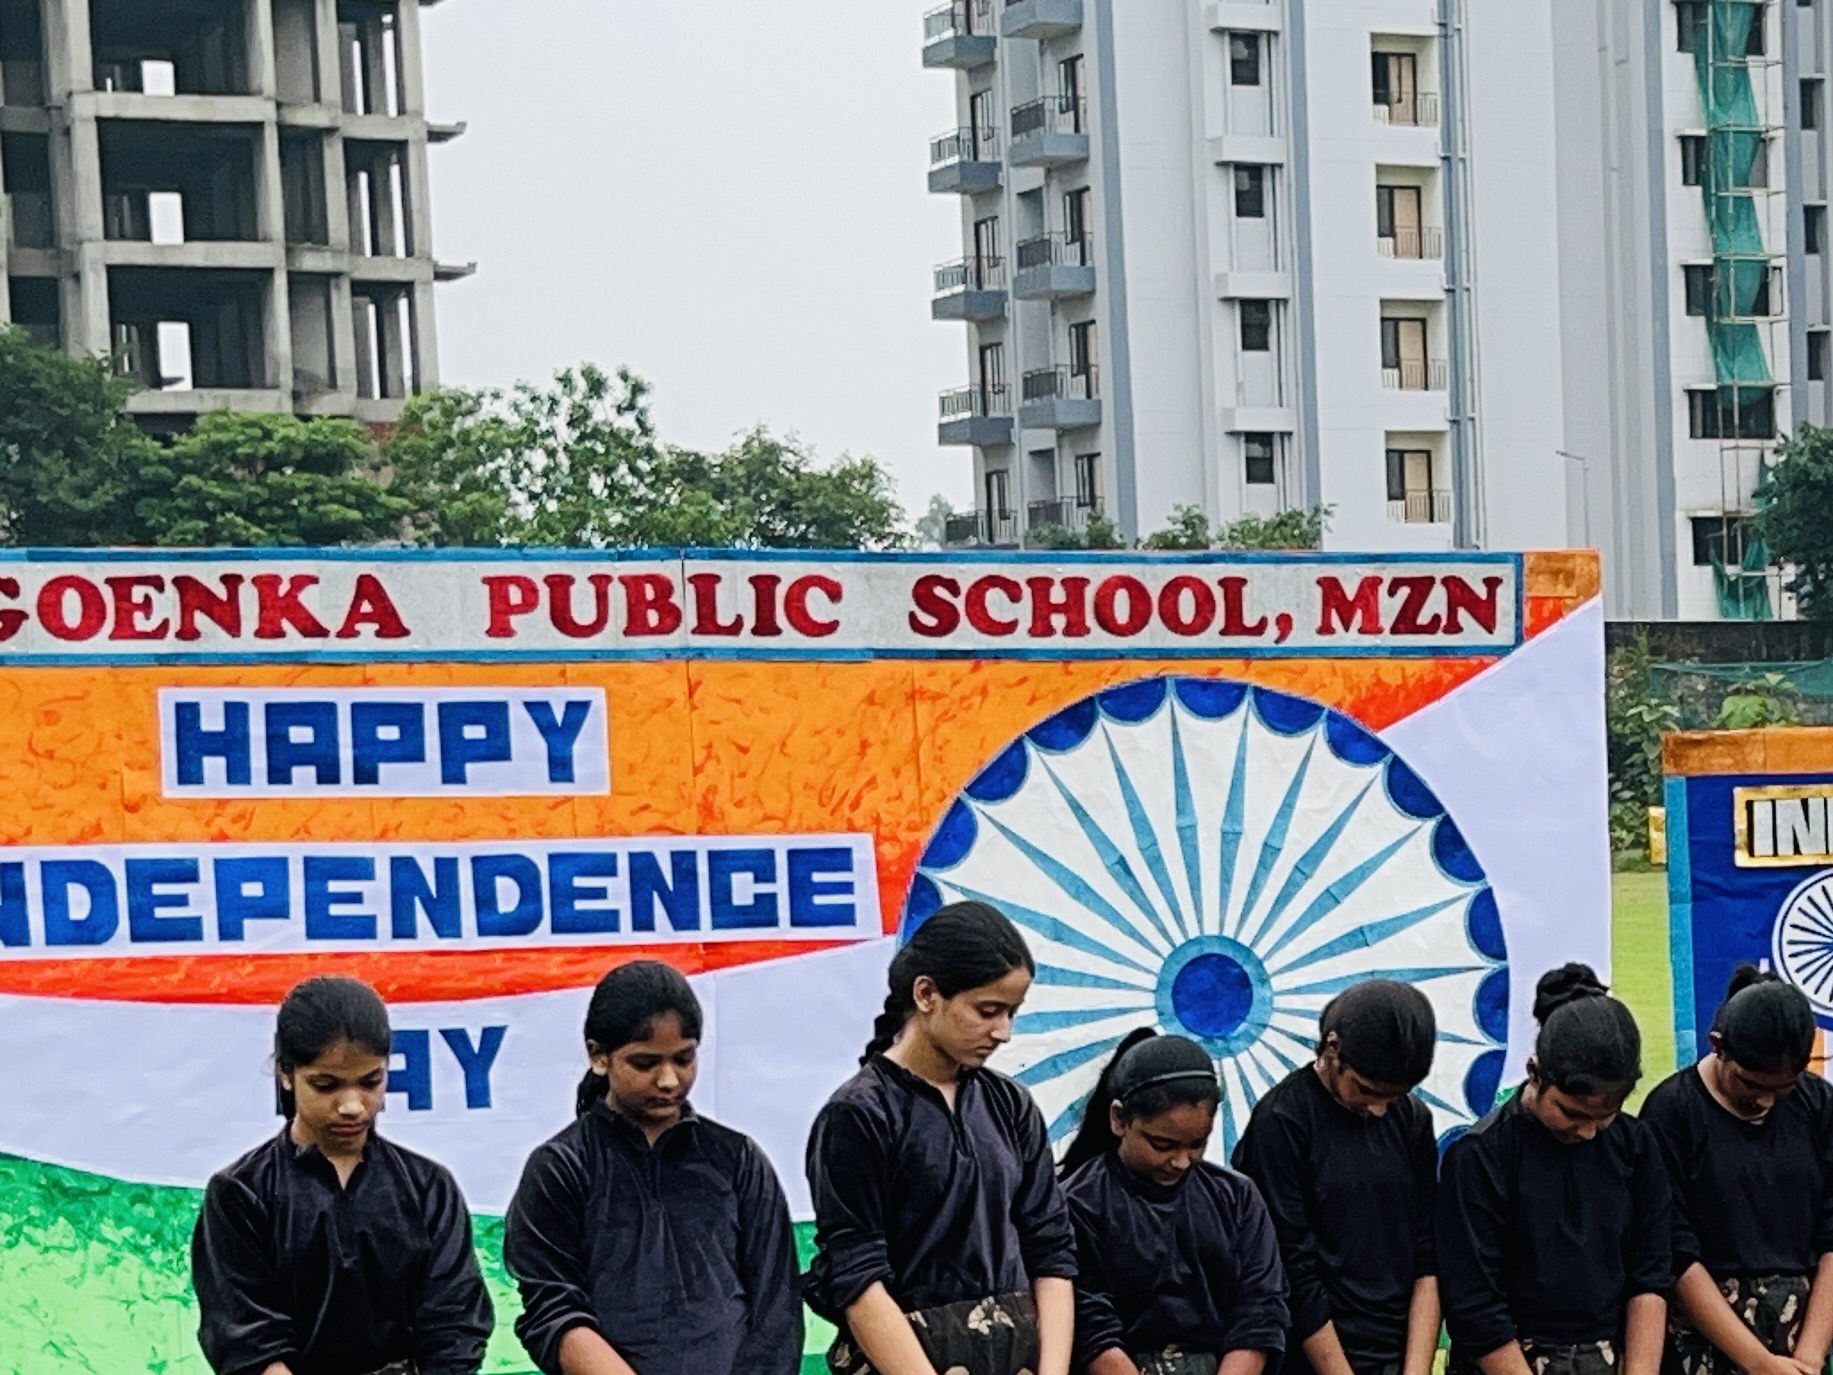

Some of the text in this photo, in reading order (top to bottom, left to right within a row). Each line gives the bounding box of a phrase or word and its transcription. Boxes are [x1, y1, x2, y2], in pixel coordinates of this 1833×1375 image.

[482, 573, 842, 638] PUBLIC
[909, 574, 1293, 644] SCHOOL,
[1317, 575, 1503, 636] MZN
[174, 700, 591, 785] HAPPY
